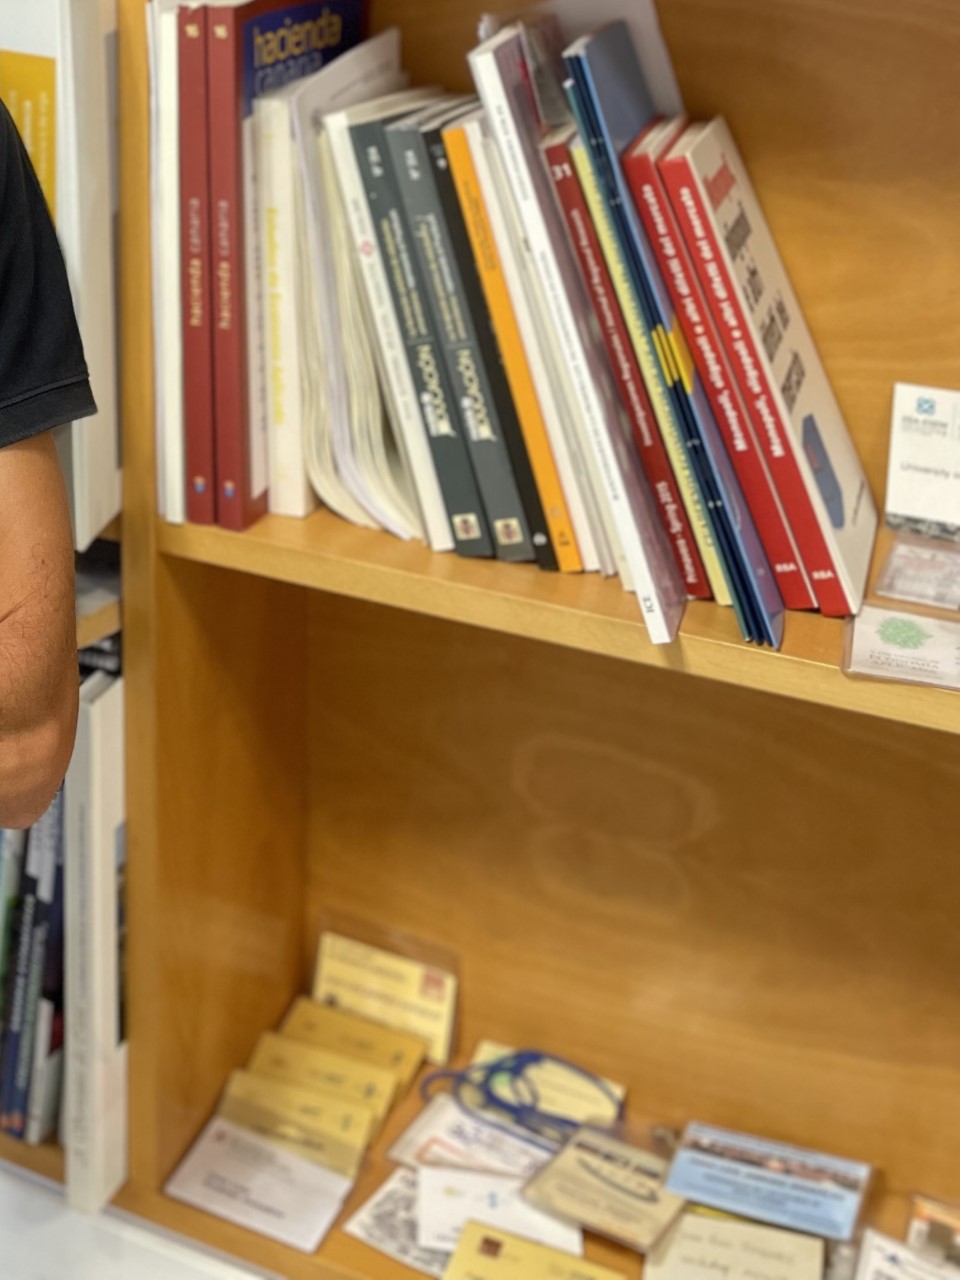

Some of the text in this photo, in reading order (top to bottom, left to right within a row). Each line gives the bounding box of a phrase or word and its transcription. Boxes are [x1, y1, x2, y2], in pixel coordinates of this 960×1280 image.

[253, 7, 343, 67] hacienda
[550, 161, 574, 182] 31
[188, 197, 203, 327] hacienda canaria
[216, 199, 231, 330] hacienda canaria
[639, 182, 750, 453] Monopoli, oligopoli e altri difetti del mercato
[676, 185, 788, 458] Monopoli, oligopoli e altri difetti del mercato
[640, 593, 656, 614] ICE
